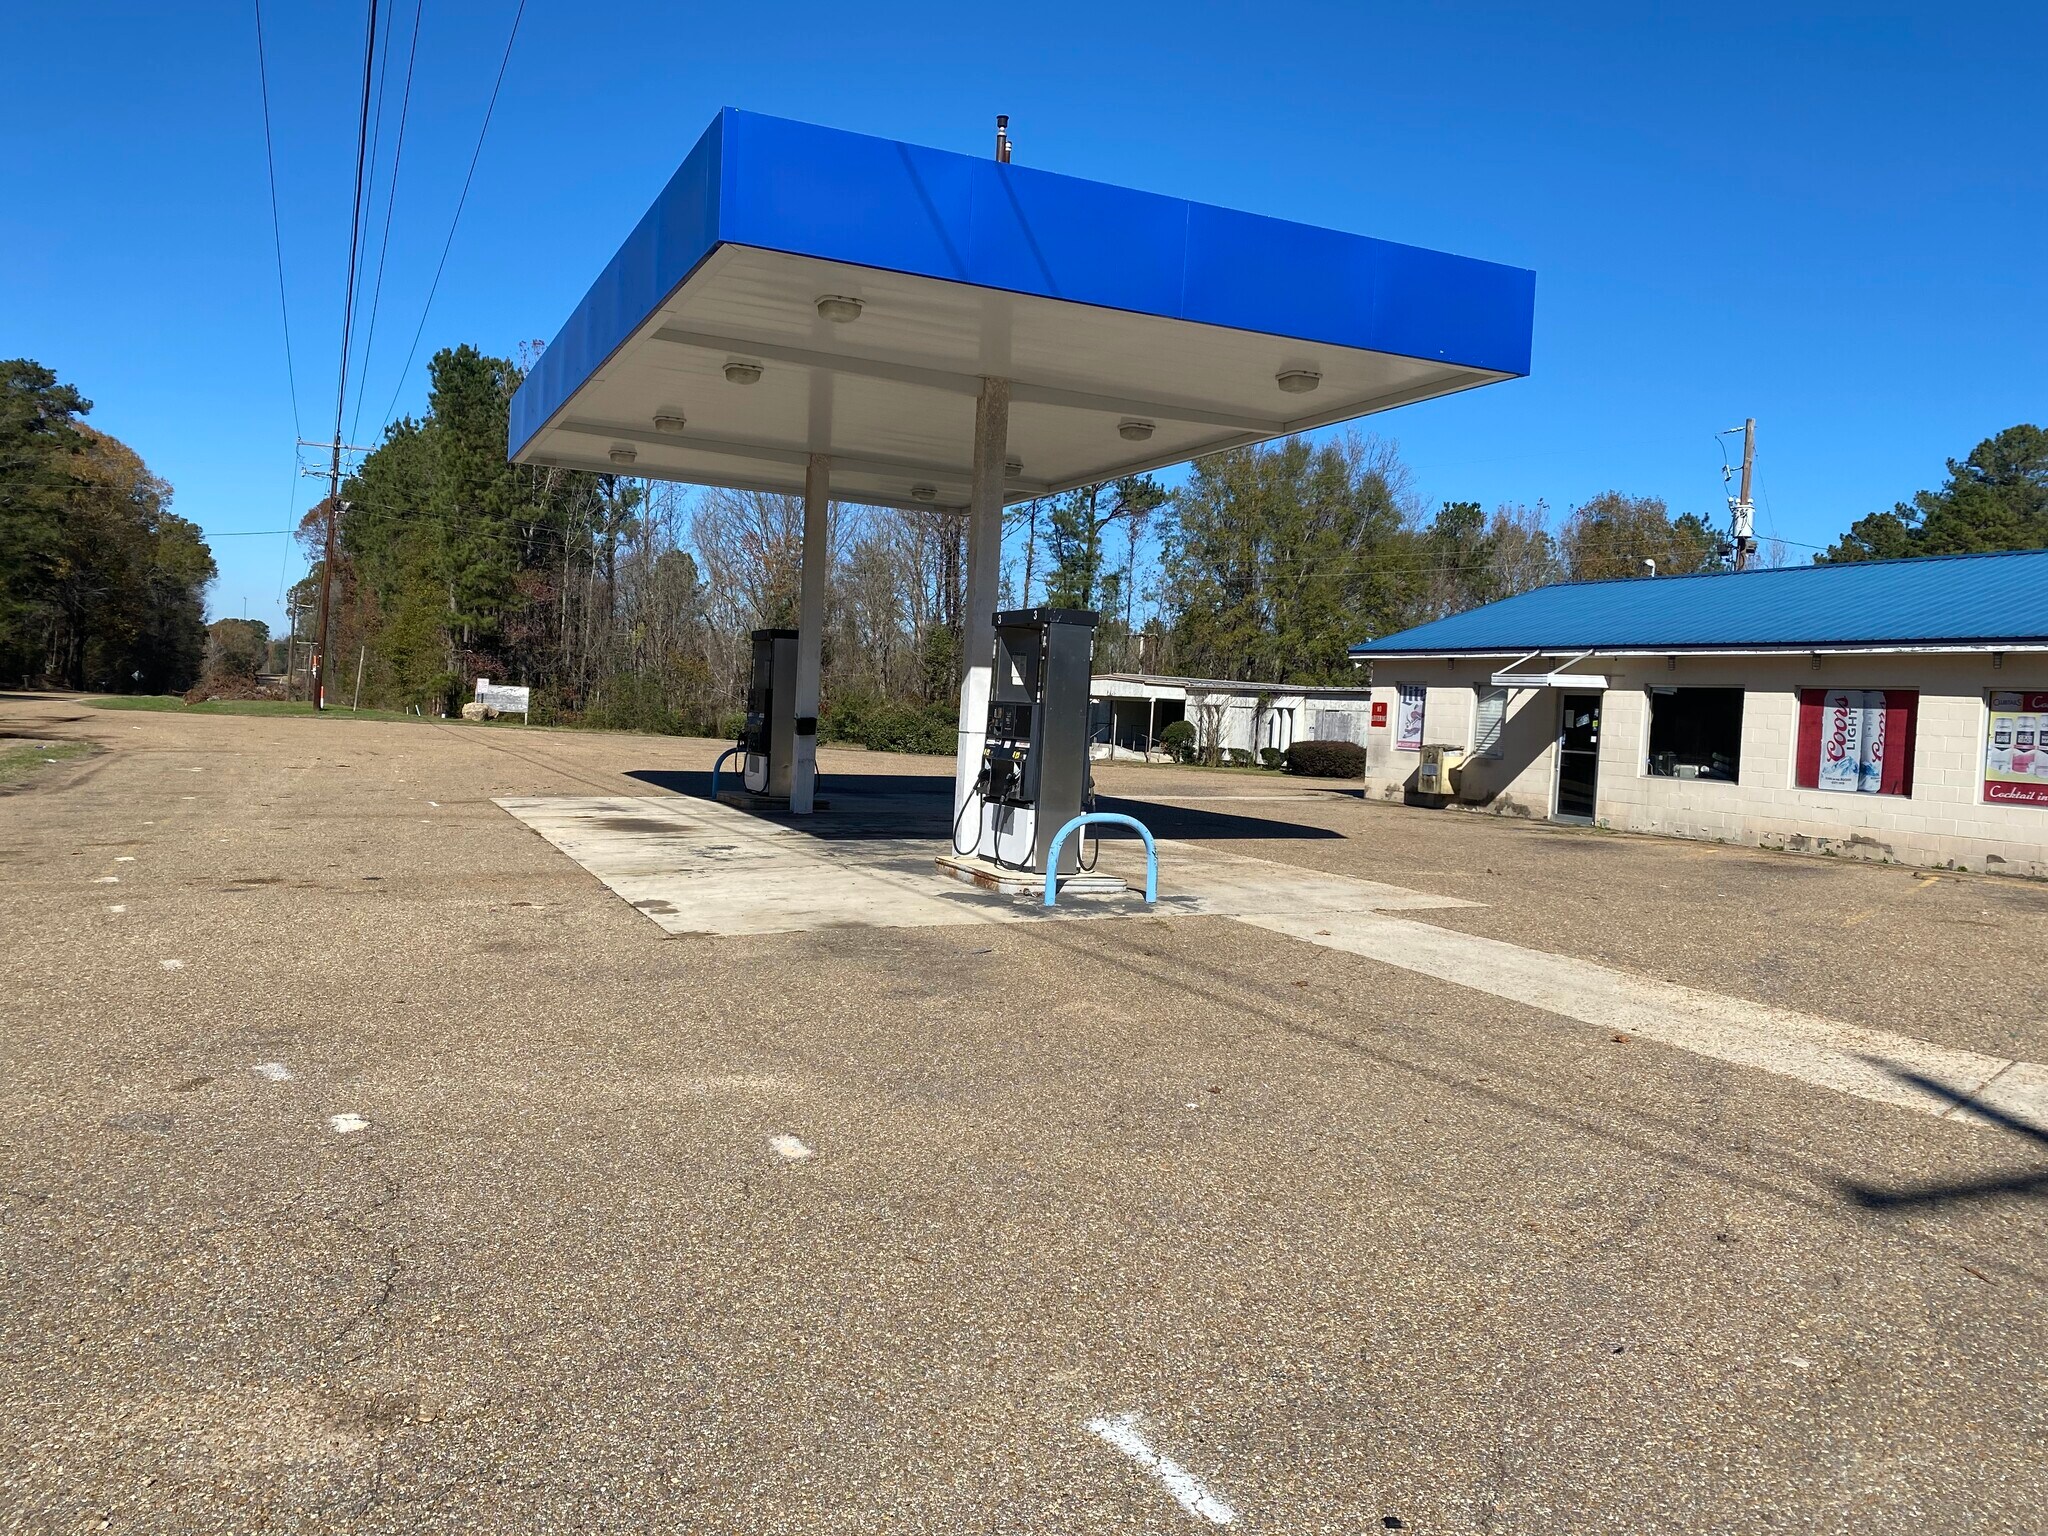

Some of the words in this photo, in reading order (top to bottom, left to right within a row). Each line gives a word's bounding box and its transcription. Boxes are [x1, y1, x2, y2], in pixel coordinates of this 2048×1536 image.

[997, 614, 1002, 624] 3
[1033, 610, 1038, 620] 3
[1827, 696, 1849, 762] Coors
[1847, 707, 1858, 751] LIGHT
[1990, 785, 2036, 800] Cocktail
